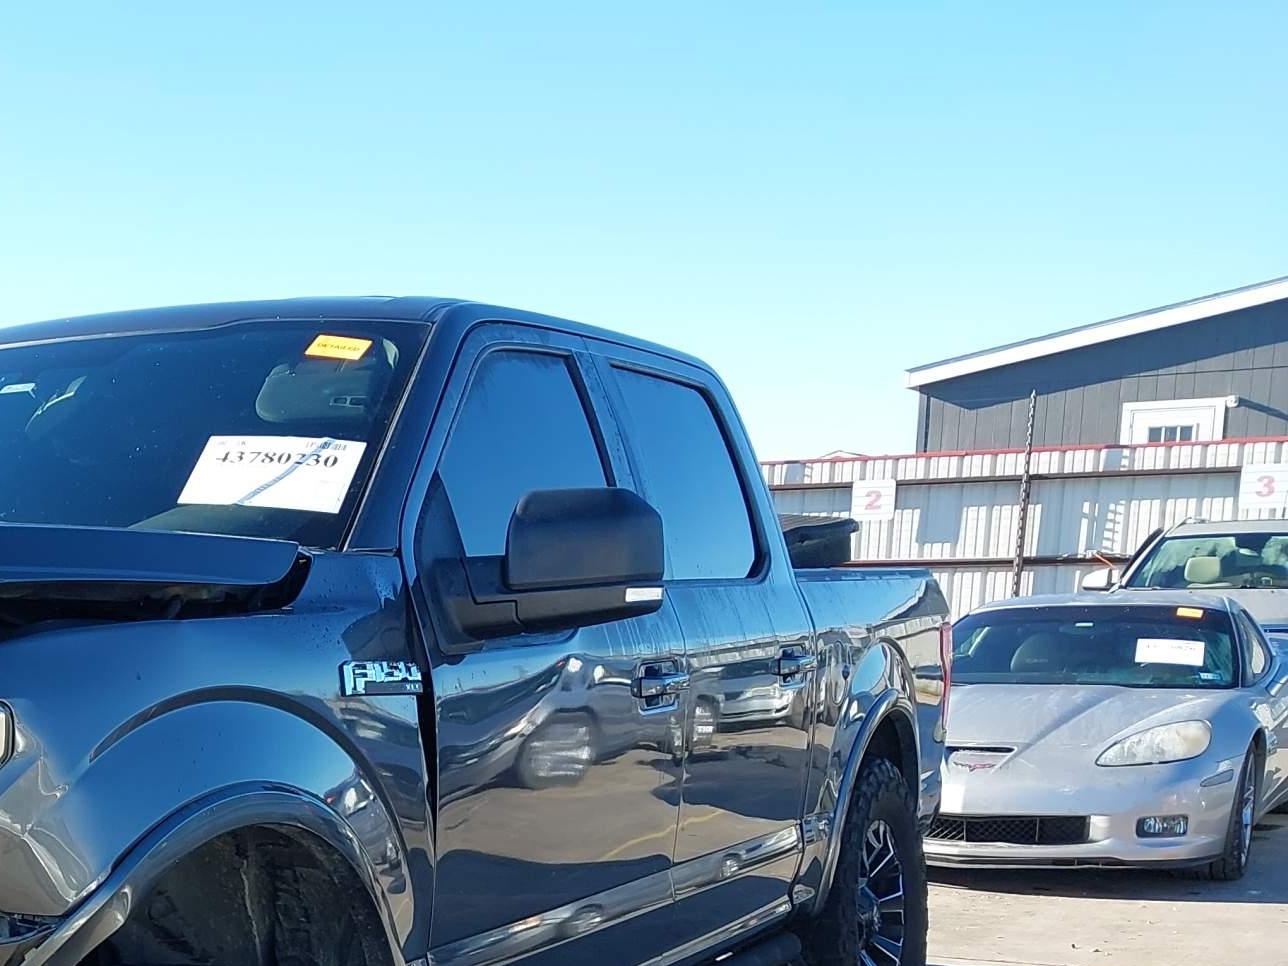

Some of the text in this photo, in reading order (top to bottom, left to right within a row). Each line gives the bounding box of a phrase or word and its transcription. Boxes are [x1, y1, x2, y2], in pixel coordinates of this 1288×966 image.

[216, 450, 339, 468] 43780230
[1255, 475, 1275, 497] 3
[864, 490, 882, 510] 2
